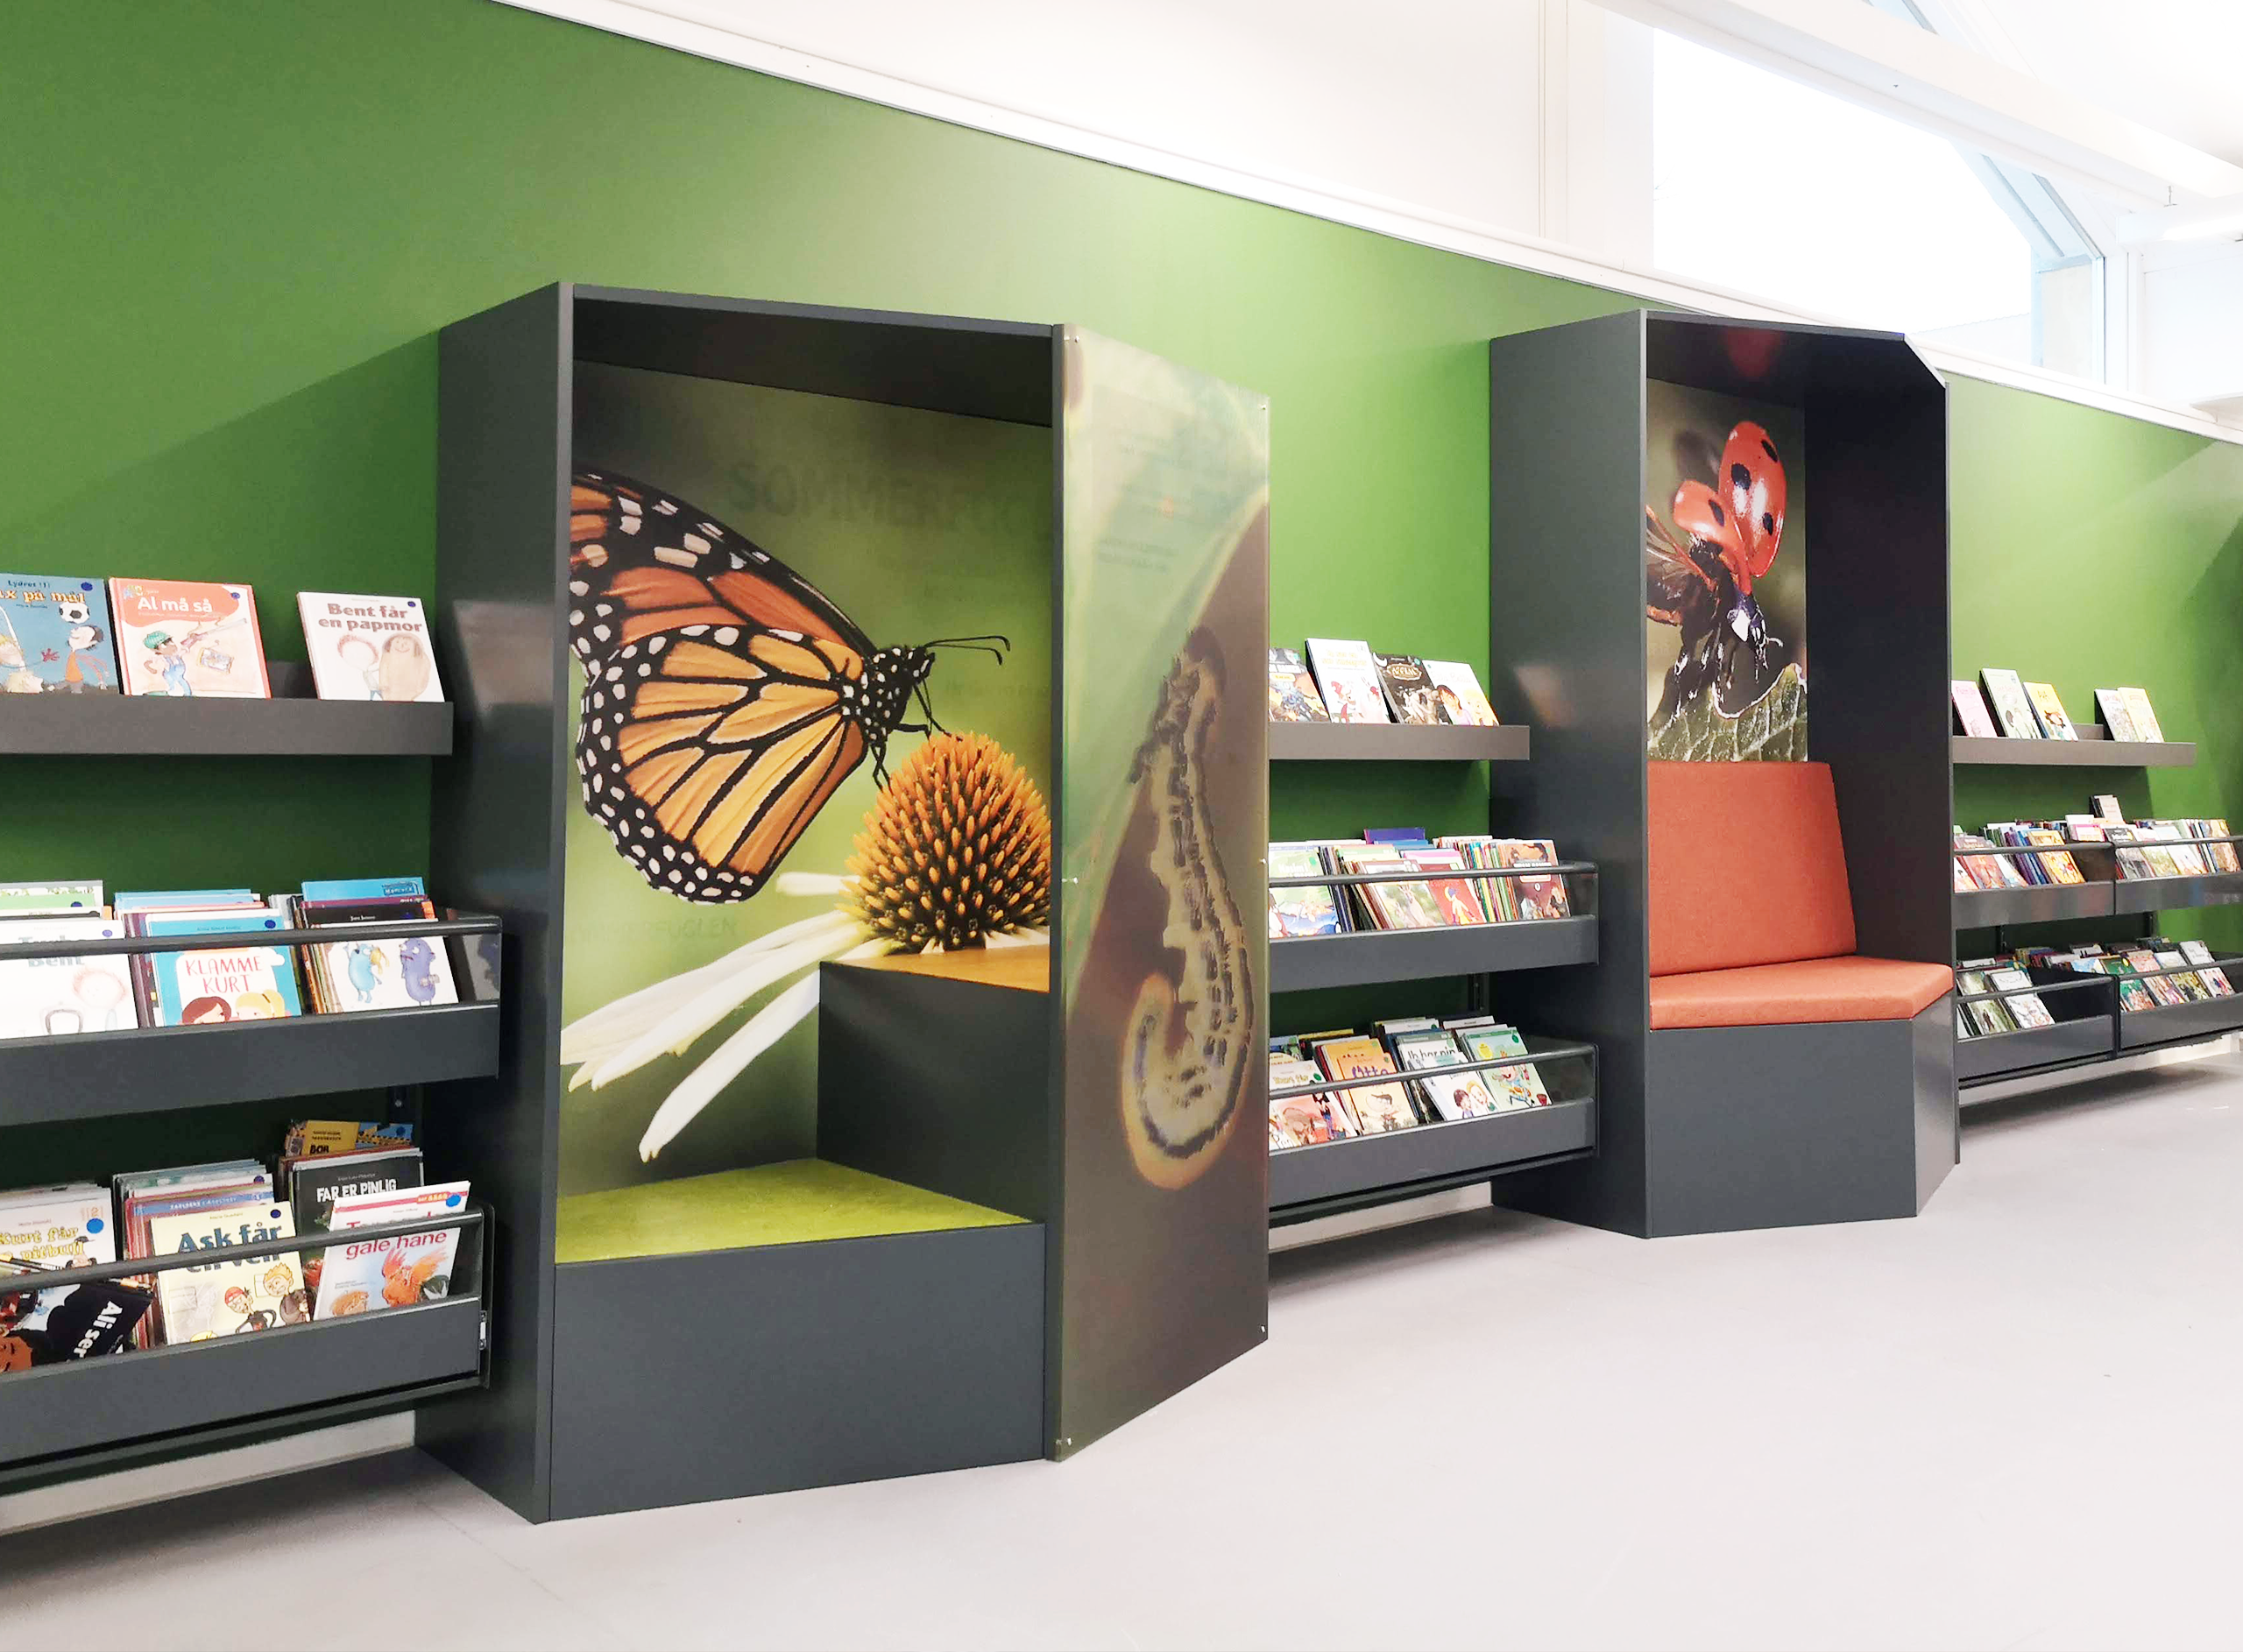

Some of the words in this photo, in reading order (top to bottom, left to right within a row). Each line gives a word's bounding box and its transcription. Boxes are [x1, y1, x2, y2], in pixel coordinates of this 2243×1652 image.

[0, 589, 18, 599] x
[23, 589, 46, 604] på
[51, 591, 85, 603] mål
[138, 597, 158, 611] Al
[161, 597, 189, 612] må
[194, 598, 213, 612] så
[328, 603, 377, 618] Bent
[379, 605, 408, 618] får
[318, 618, 342, 628] en
[346, 619, 422, 632] papmor
[186, 956, 263, 976] KLAMME
[202, 974, 250, 993] KURT
[1352, 1064, 1389, 1078] Otto
[316, 1186, 339, 1203] FAR
[342, 1183, 357, 1198] ER
[0, 1230, 41, 1245] Kurt
[47, 1226, 79, 1242] får
[178, 1227, 232, 1253] Ask
[239, 1222, 282, 1245] får
[346, 1239, 391, 1260] gale
[396, 1232, 447, 1250] hane
[93, 1301, 123, 1329] Ali
[74, 1329, 101, 1359] ser
